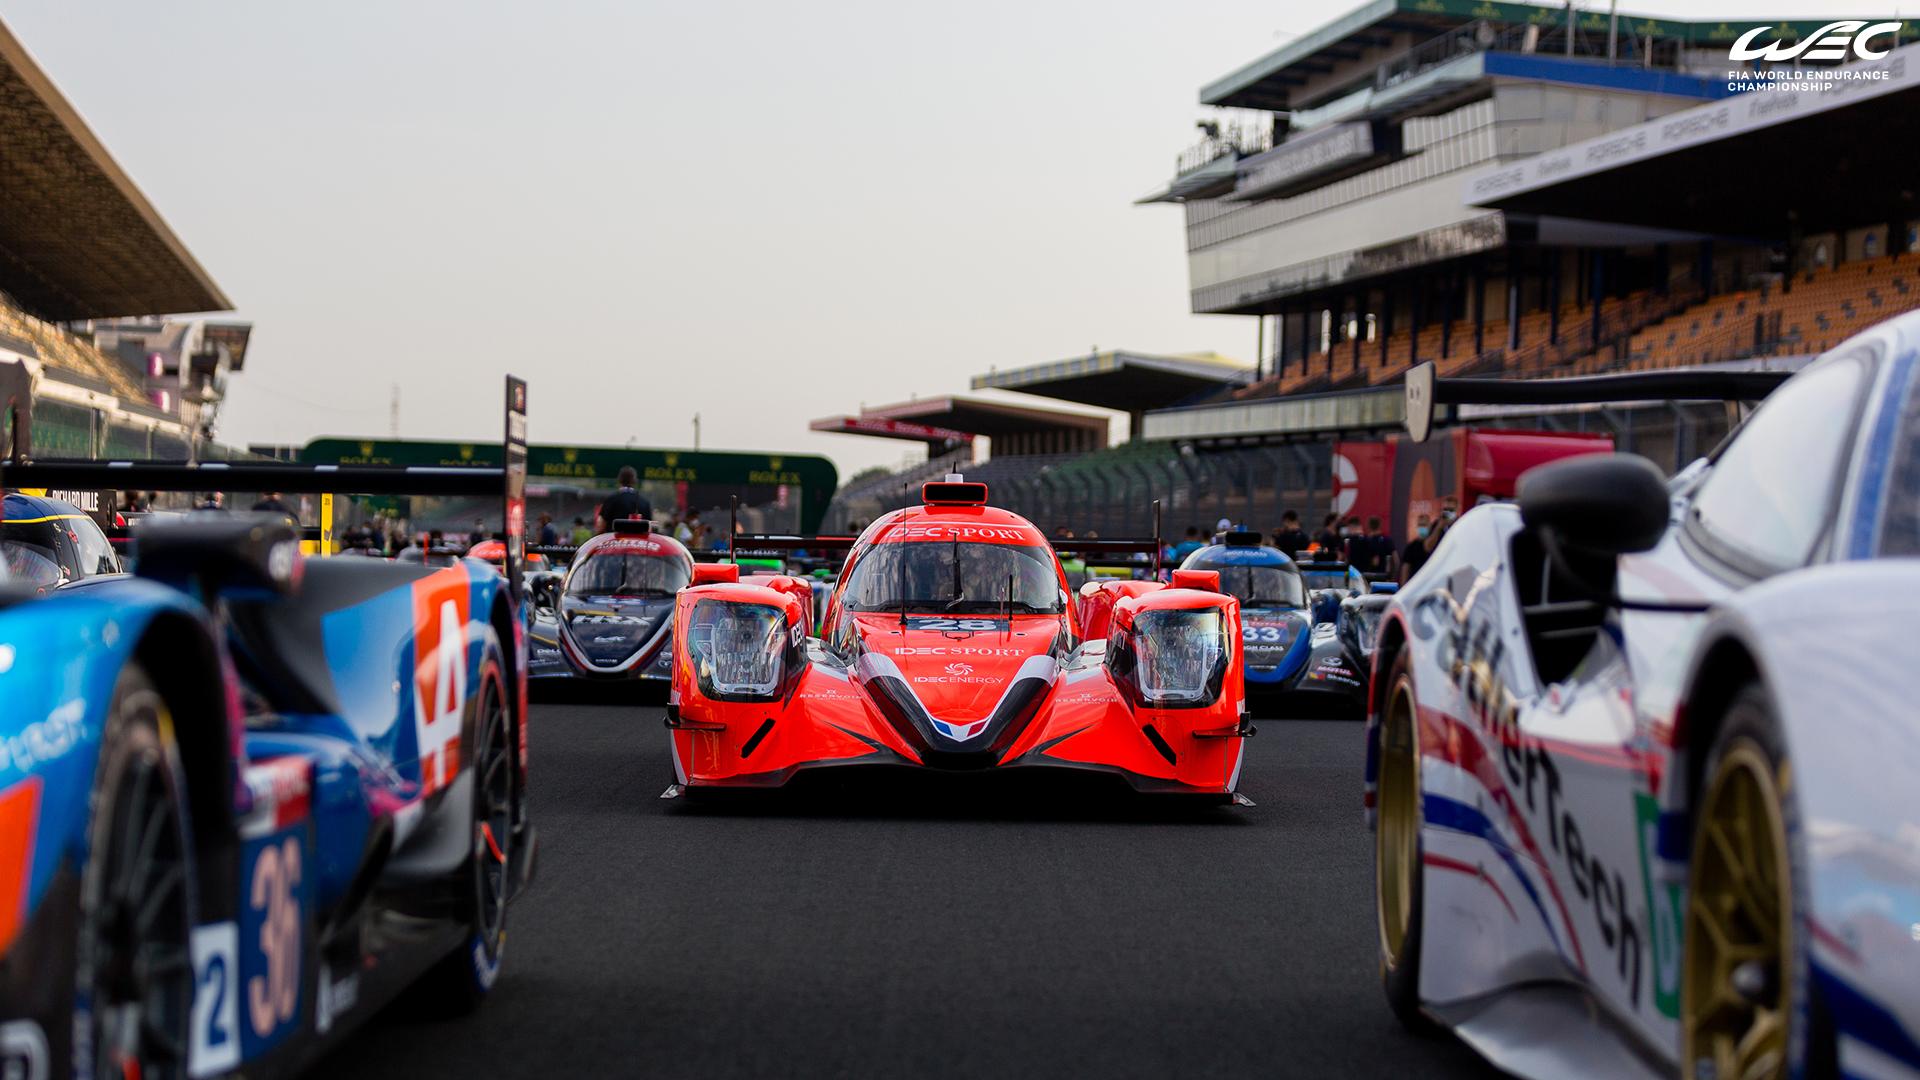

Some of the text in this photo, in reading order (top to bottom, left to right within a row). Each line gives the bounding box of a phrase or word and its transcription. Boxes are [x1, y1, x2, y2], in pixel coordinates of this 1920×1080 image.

[543, 463, 596, 477] ROLEX
[644, 467, 696, 481] ROLEX
[749, 471, 800, 484] ROLEX
[886, 527, 1025, 541] IDEC SPORT
[919, 619, 997, 631] 28
[1242, 627, 1281, 641] 33
[894, 647, 1025, 657] IDEC SPORT
[949, 676, 1004, 684] ENERGY
[249, 836, 302, 1038] 36
